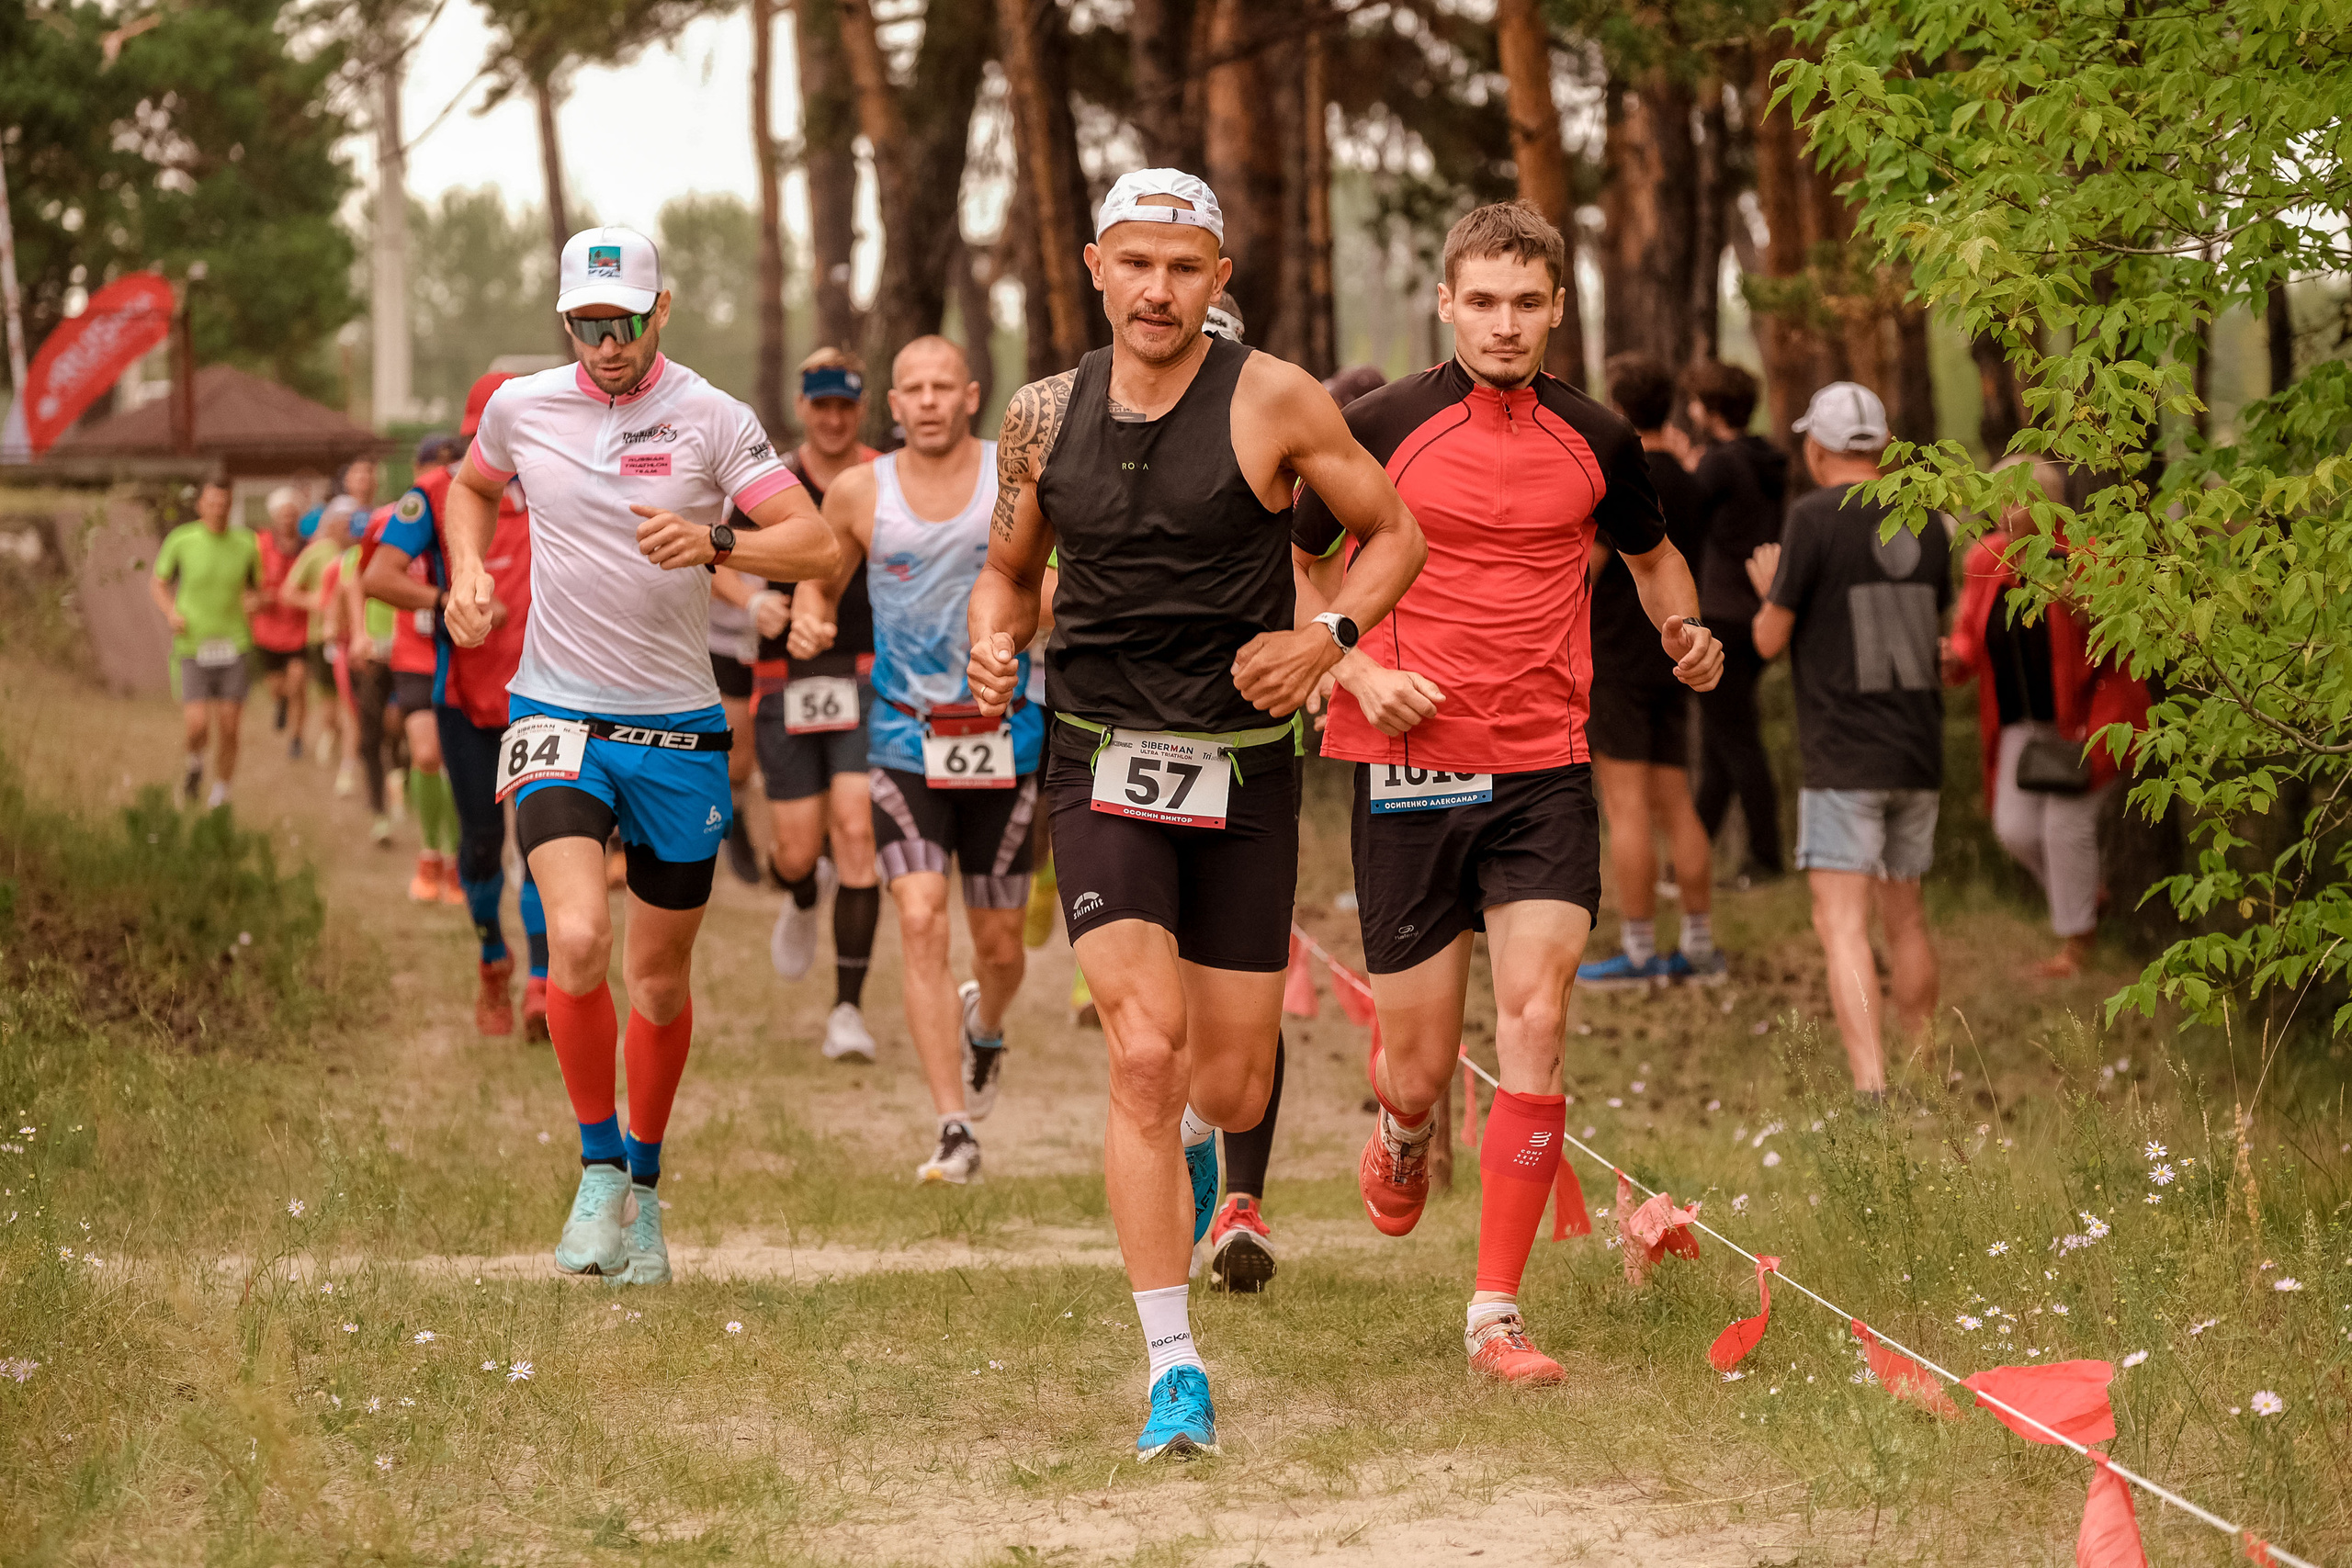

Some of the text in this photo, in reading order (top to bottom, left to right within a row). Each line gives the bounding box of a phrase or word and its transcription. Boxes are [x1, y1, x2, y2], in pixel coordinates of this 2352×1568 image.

[1122, 462, 1148, 470] ROA
[802, 691, 840, 720] 56
[508, 735, 560, 776] 84
[1141, 740, 1194, 754] SIBERMAN
[945, 744, 994, 773] 62
[1125, 756, 1203, 809] 57
[1385, 795, 1478, 809] ОСИПЕНКО АЛЕКСАНДР
[1123, 808, 1193, 823] ОСОКИН ВИКТОР
[1073, 898, 1104, 920] skinfit
